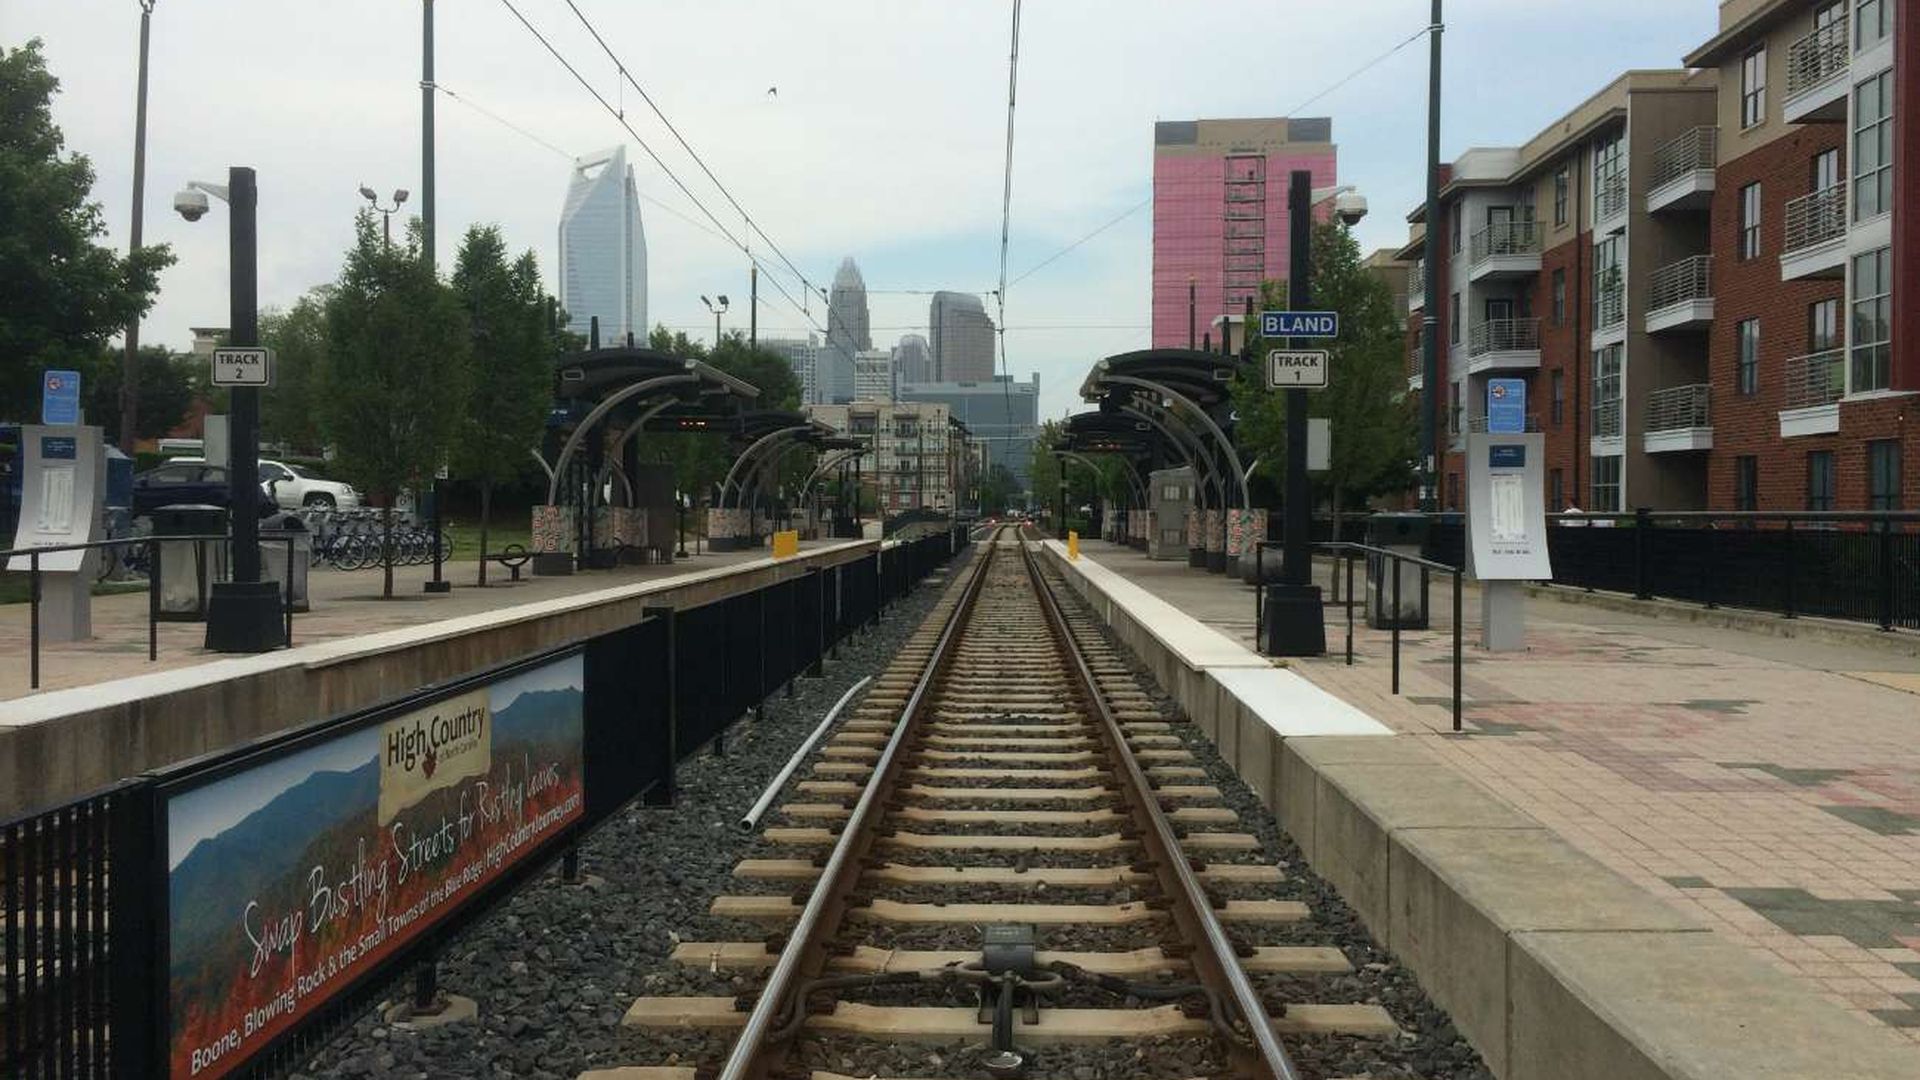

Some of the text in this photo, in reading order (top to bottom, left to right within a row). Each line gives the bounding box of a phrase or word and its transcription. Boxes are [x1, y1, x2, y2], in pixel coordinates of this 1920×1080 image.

[1265, 316, 1334, 332] BLAND
[219, 354, 259, 364] TRACK
[1278, 356, 1318, 367] TRACK
[235, 367, 243, 379] 2
[1294, 370, 1301, 381] 1
[387, 720, 426, 772] High
[431, 705, 485, 748] Country
[244, 901, 303, 989] Swap
[307, 837, 388, 933] Bustling
[392, 816, 454, 884] Streets
[458, 790, 475, 845] for
[476, 763, 523, 831] Rustling
[190, 793, 581, 1075] Boone, Blowing Rock & the Small Towns of the Blue Ridge HighCountryJourney.com
